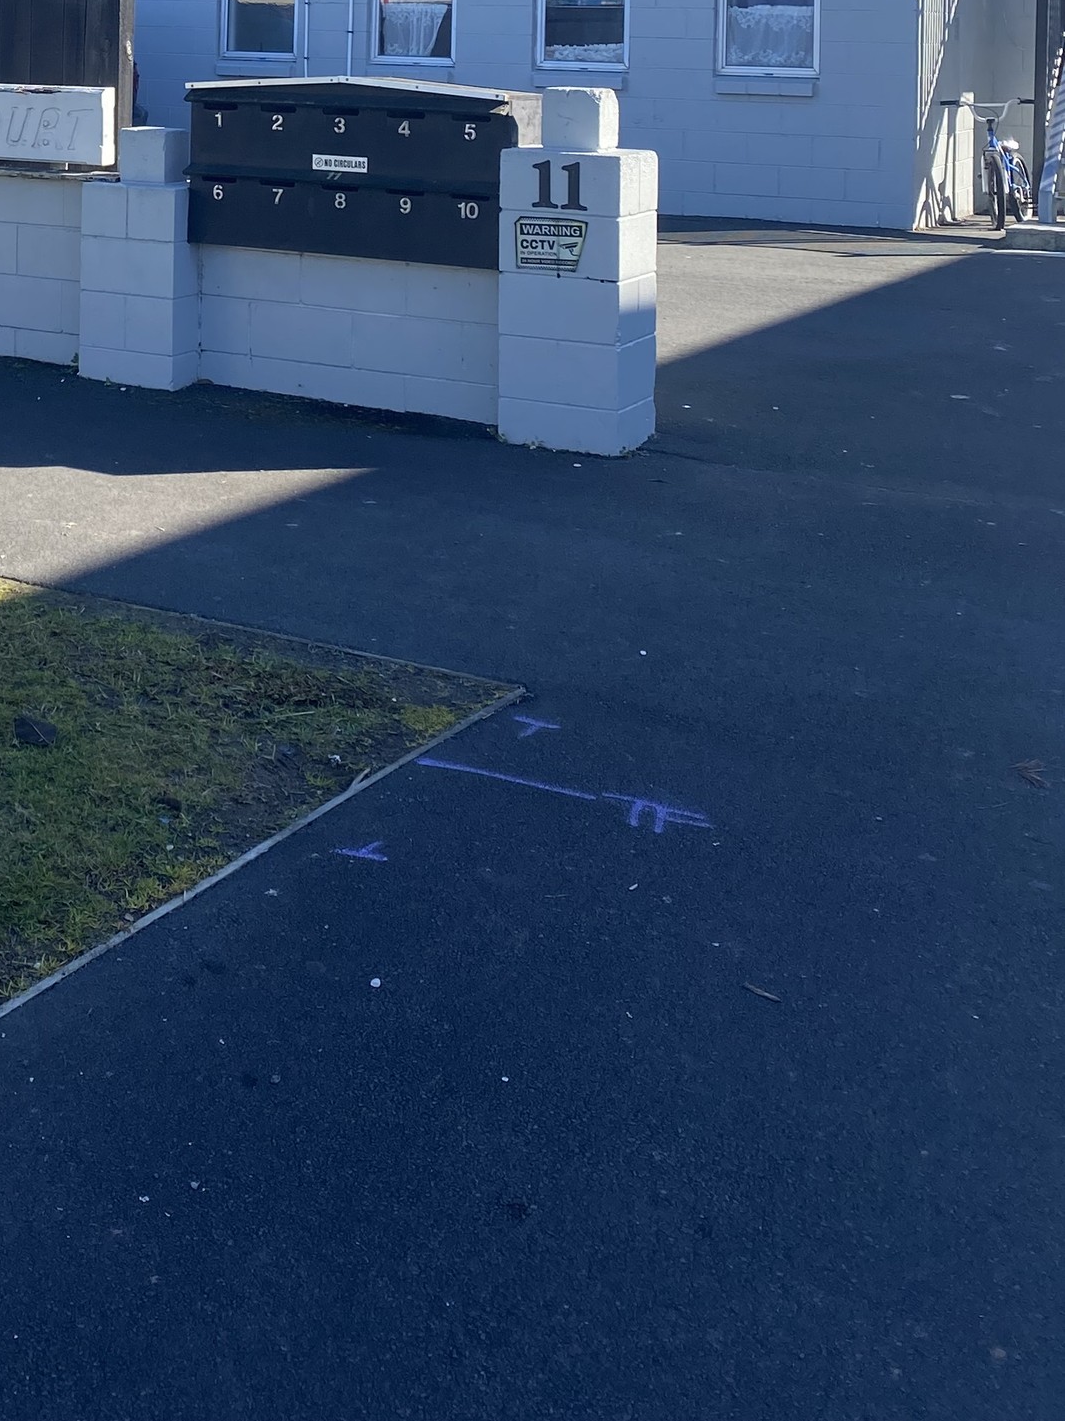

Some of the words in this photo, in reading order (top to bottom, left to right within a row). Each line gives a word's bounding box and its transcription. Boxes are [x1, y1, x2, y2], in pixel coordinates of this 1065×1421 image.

[214, 112, 222, 127] 1
[271, 114, 284, 131] 2
[334, 118, 345, 133] 3
[397, 121, 411, 137] 4
[463, 124, 477, 140] 5
[324, 159, 333, 167] NO
[334, 159, 366, 169] CIRCULARS
[212, 185, 224, 200] 6
[532, 160, 588, 211] 11
[272, 188, 284, 205] 7
[334, 193, 346, 209] 8
[399, 198, 412, 214] 9
[457, 202, 479, 219] 10
[522, 225, 580, 236] WARNING
[520, 239, 555, 250] CCTV
